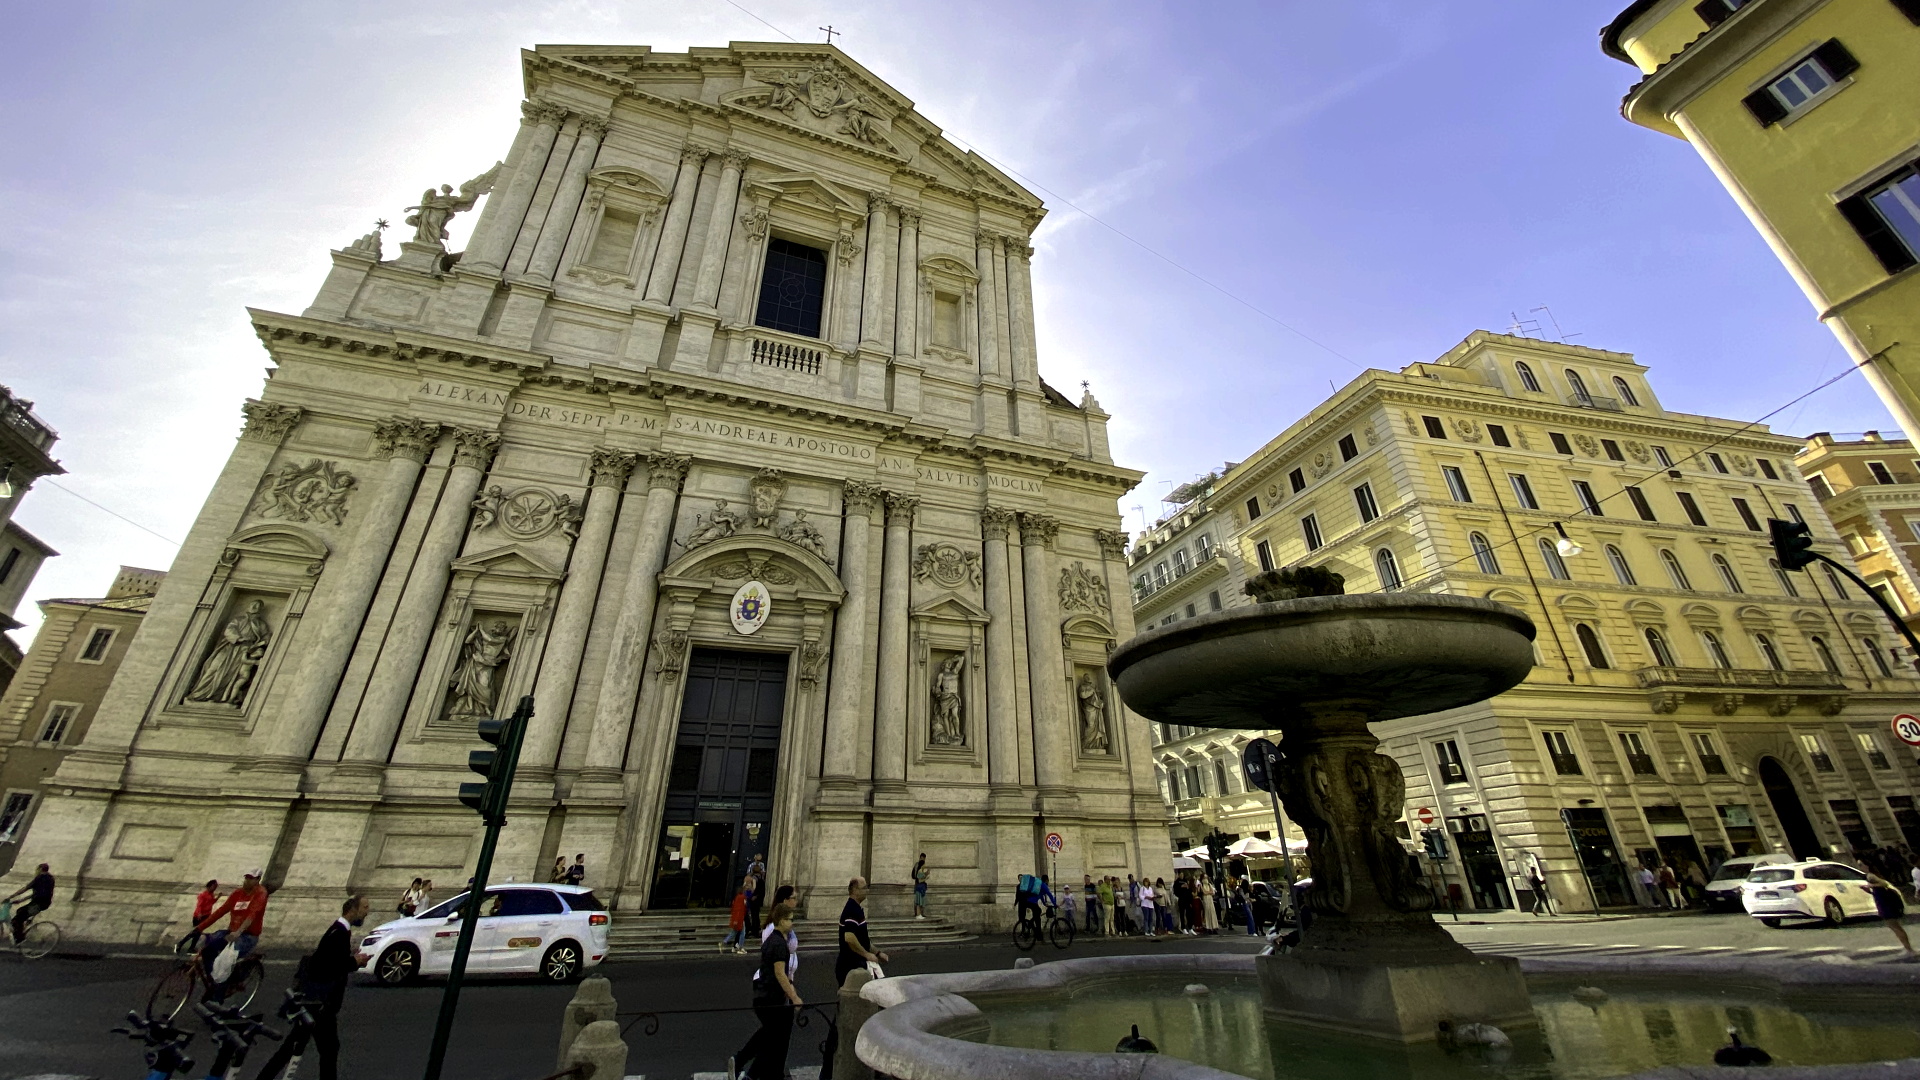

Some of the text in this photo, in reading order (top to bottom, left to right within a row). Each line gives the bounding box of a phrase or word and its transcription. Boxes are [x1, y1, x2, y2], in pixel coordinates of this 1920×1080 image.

[785, 437, 871, 459] APOSTOLO
[917, 467, 979, 487] SALVTIS
[988, 475, 1044, 493] MDCLXV
[1899, 721, 1920, 738] 30
